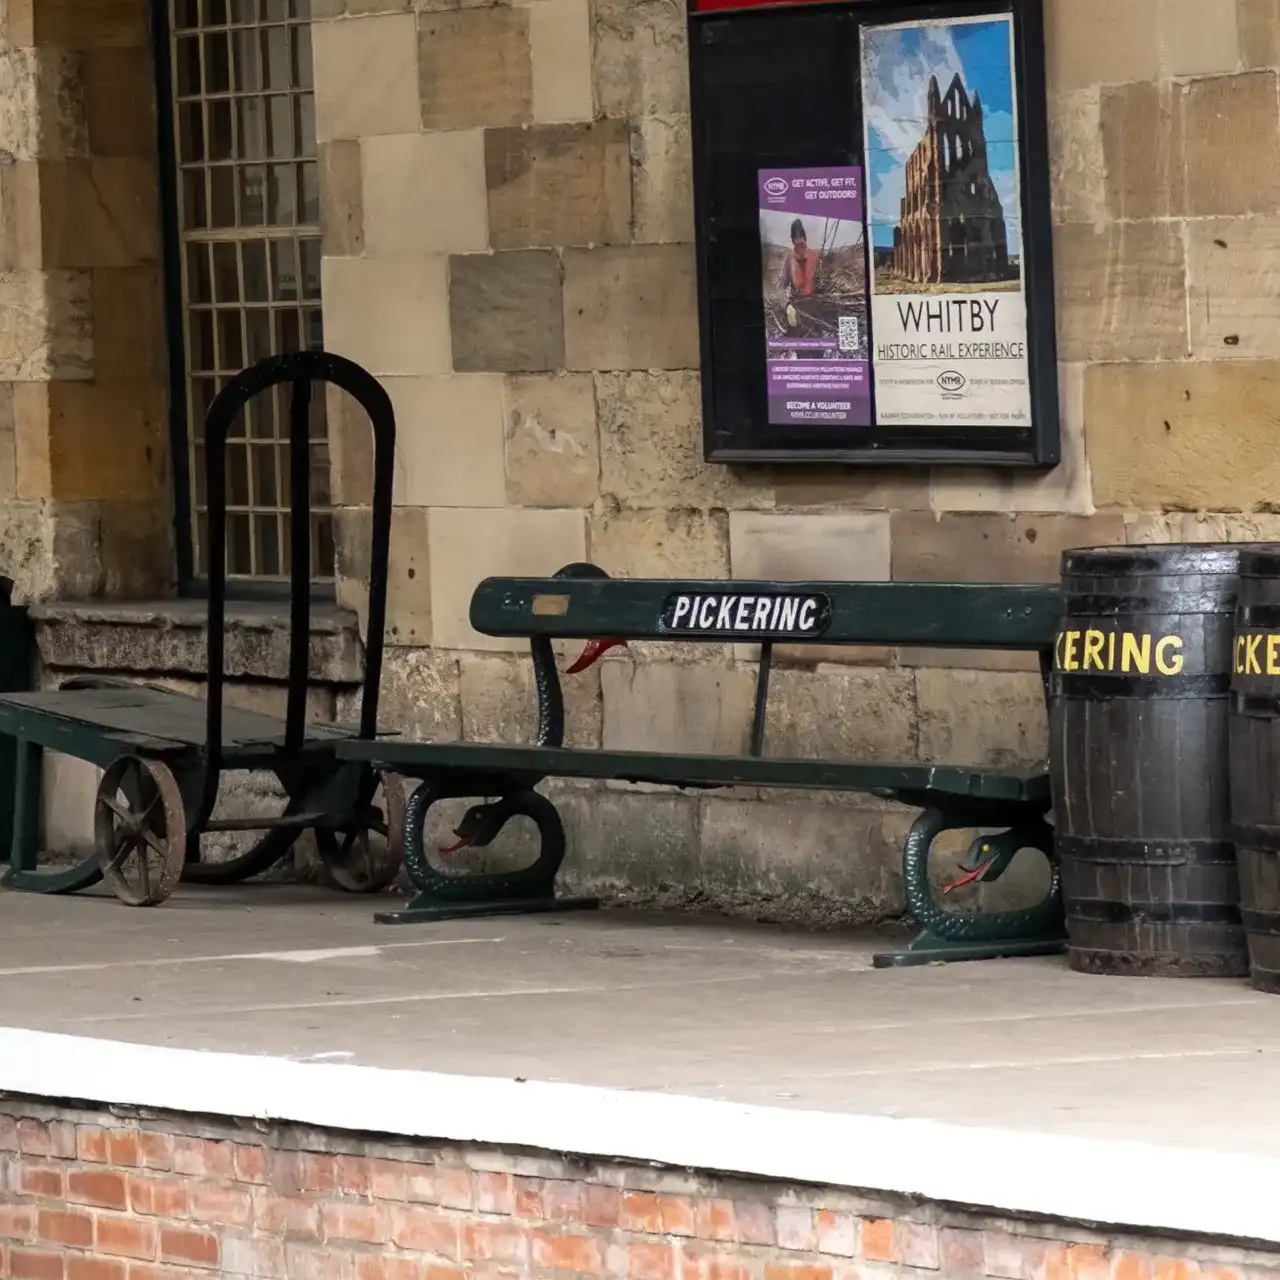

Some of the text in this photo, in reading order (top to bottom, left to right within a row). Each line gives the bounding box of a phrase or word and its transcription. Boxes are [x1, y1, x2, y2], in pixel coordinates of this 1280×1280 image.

[792, 179, 804, 188] GET
[831, 178, 844, 187] GET
[805, 191, 818, 199] GET
[897, 298, 1000, 333] WHITBY
[878, 342, 1025, 358] HISTORIC RAIL EXPERIENCE
[941, 376, 961, 385] NYMR
[786, 401, 810, 410] BECOME
[817, 401, 851, 410] VOLUNTEER
